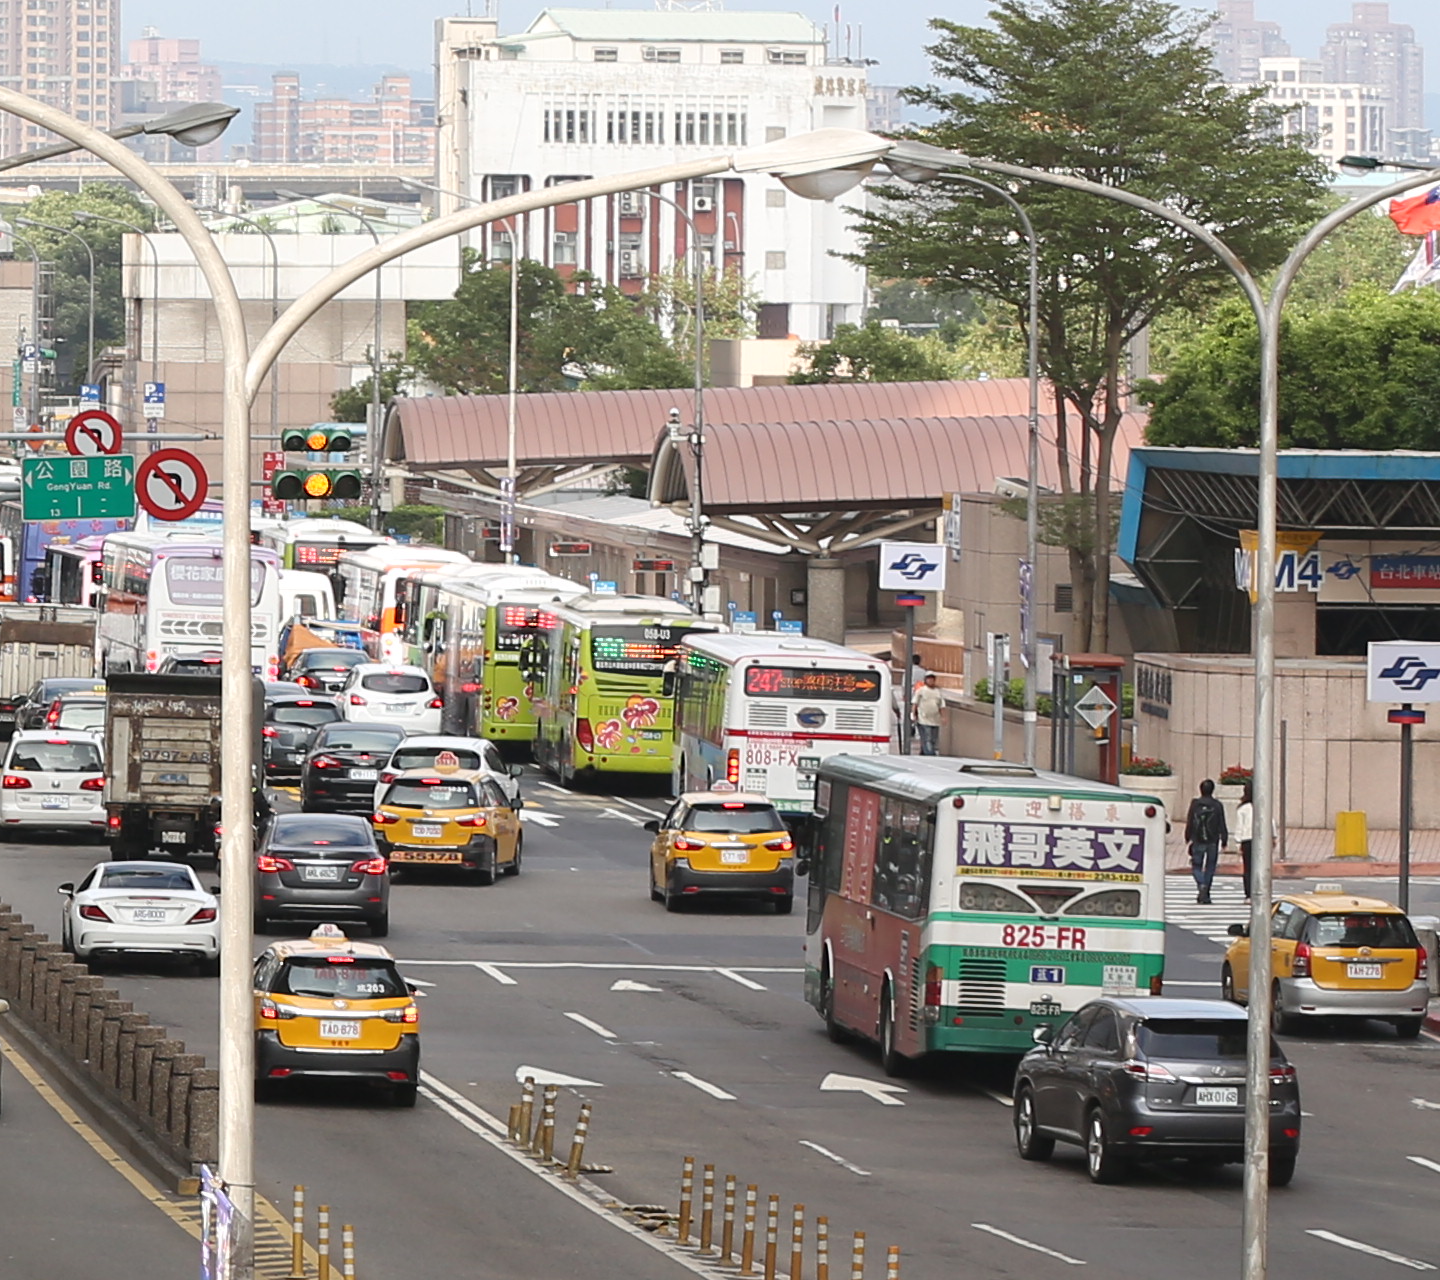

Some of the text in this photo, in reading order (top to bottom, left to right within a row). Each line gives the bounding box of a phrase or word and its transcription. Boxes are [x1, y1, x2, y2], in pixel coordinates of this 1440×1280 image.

[36, 461, 122, 479] 公園路
[47, 483, 112, 494] GongYuan Rd.
[748, 669, 779, 691] 247
[746, 750, 798, 767] 808-FX
[962, 823, 1140, 870] 飛哥英文
[1002, 924, 1086, 950] 825-FR
[1030, 1003, 1061, 1017] 825-FR
